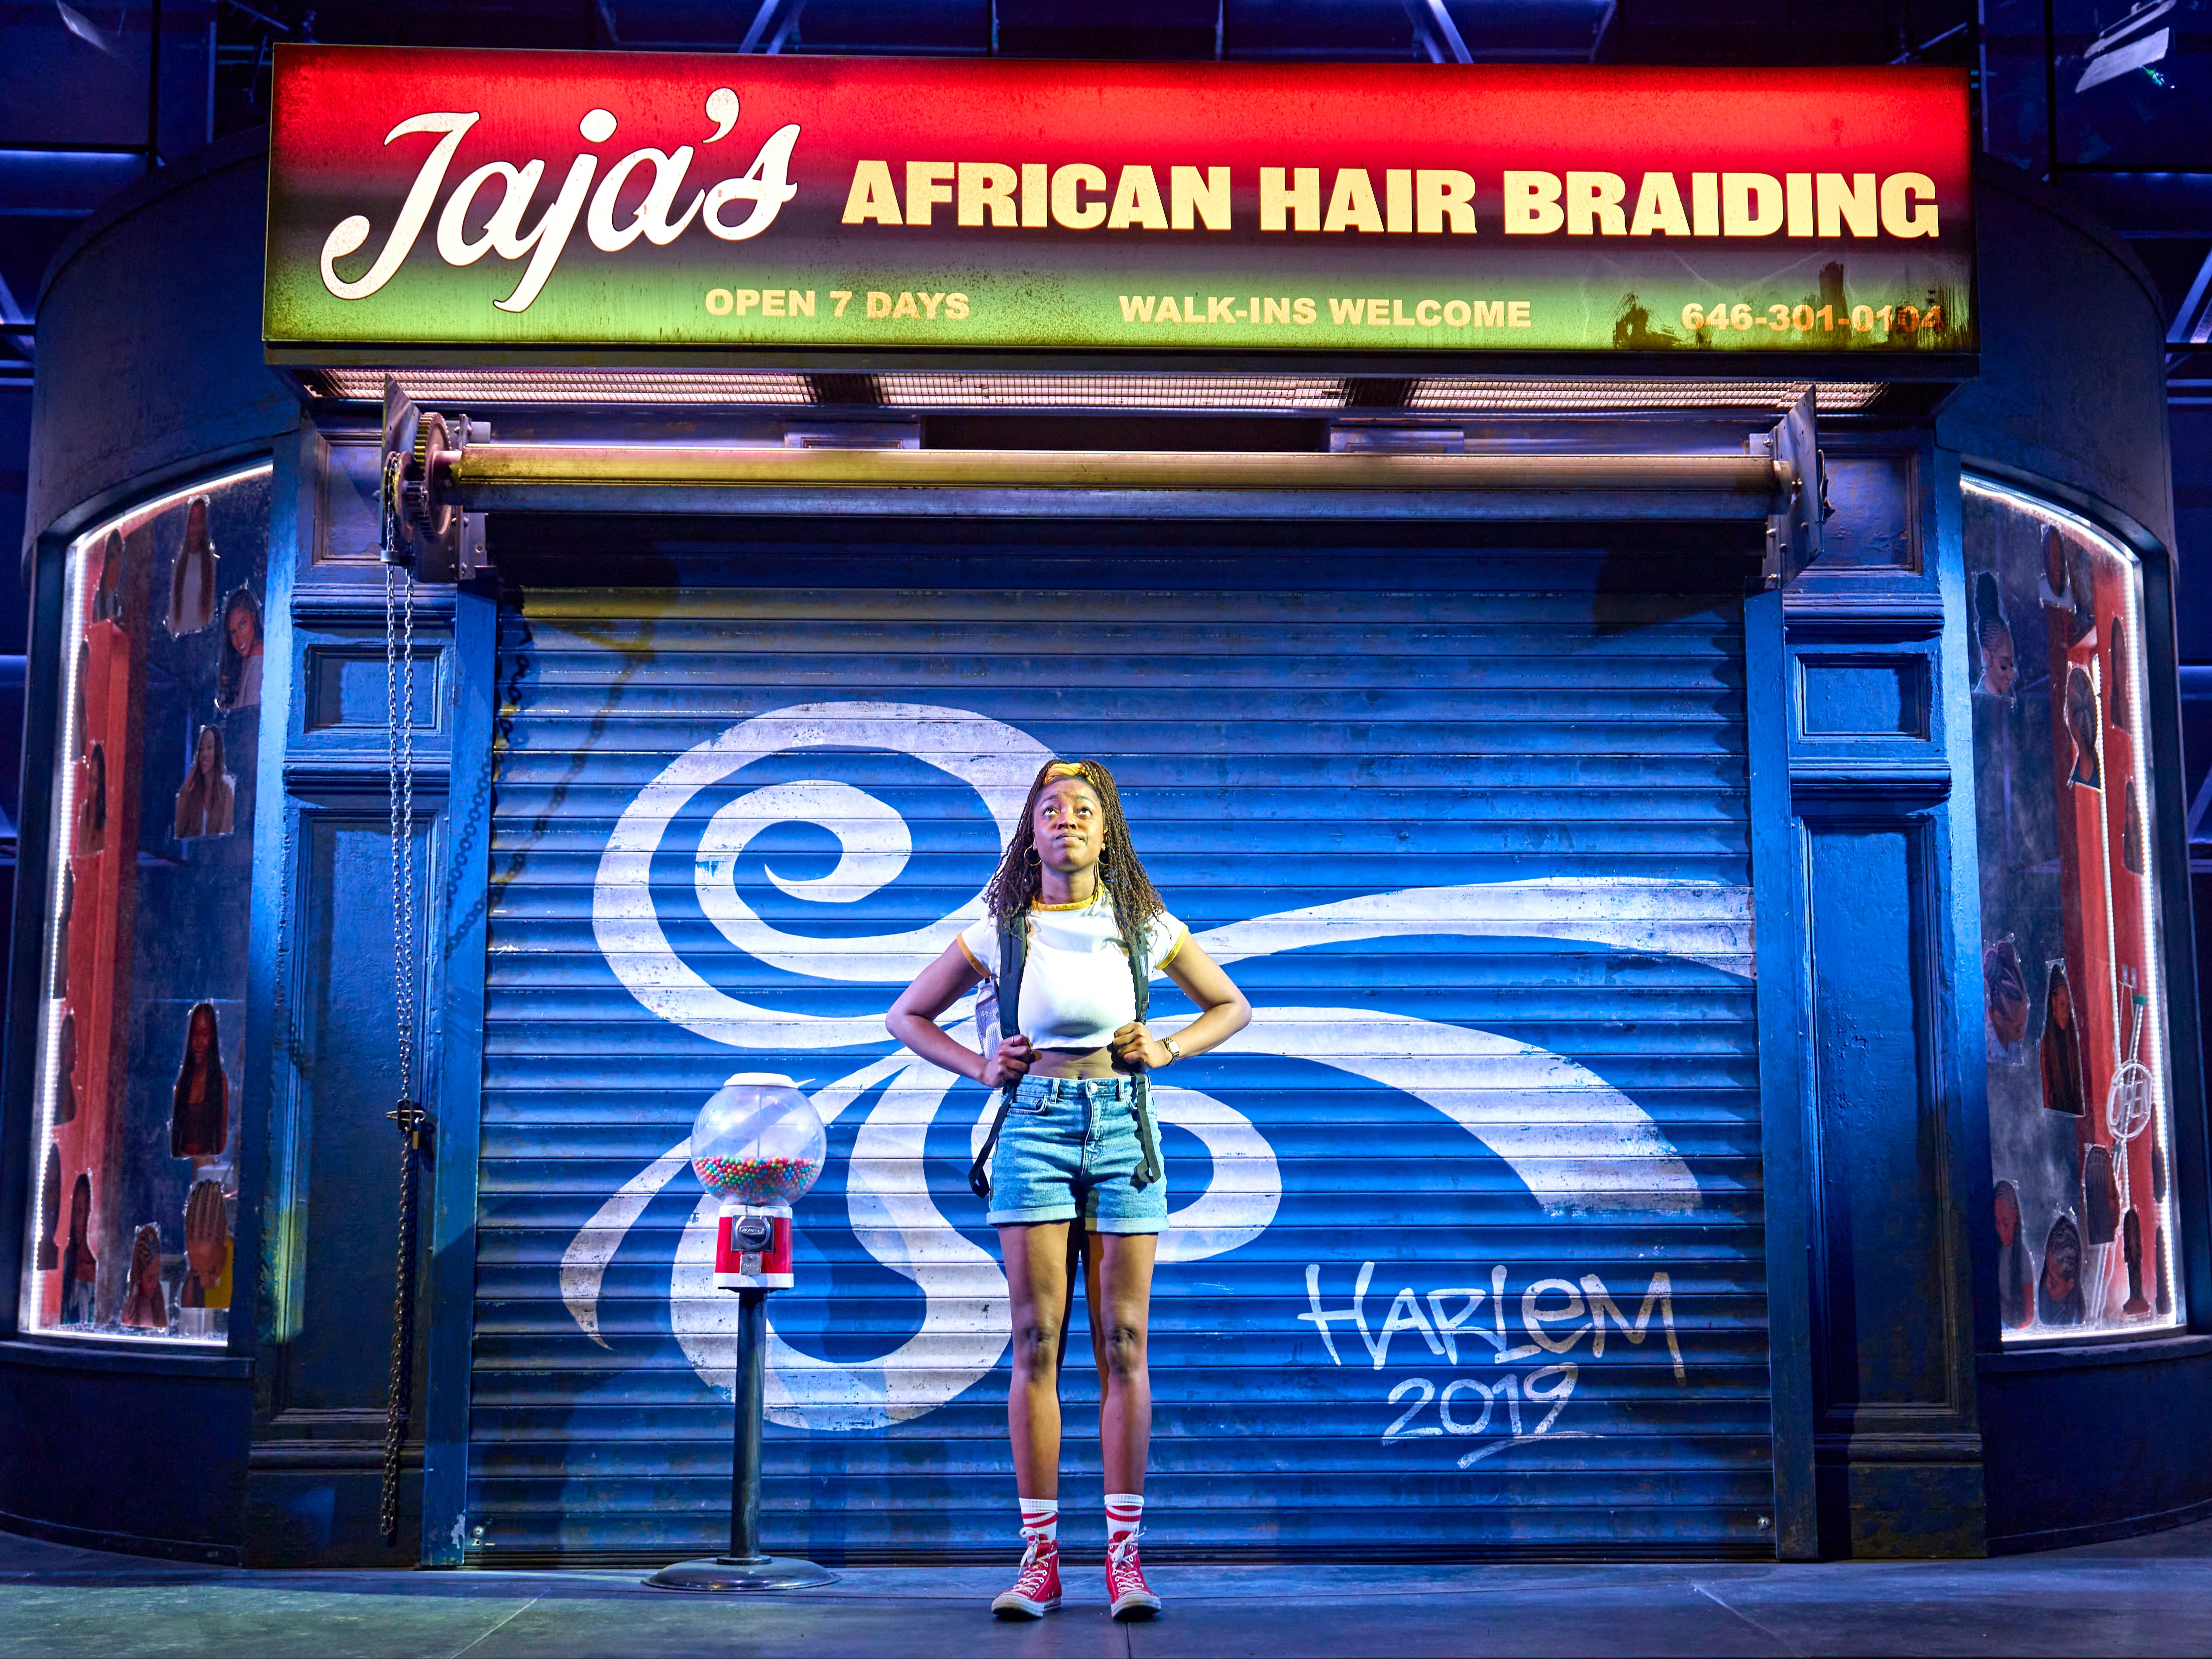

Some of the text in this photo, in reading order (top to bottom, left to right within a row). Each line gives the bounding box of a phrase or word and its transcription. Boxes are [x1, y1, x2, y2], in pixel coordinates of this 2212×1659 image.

[320, 88, 1939, 313] Jaja's AFRICAN HAIR BRAIDING
[705, 288, 970, 321] OPEN 7 DAYS
[1118, 295, 1532, 331] WALK-INS WELCOME
[1681, 302, 1944, 333] 646-301-0104
[1381, 1362, 1579, 1446] 2019
